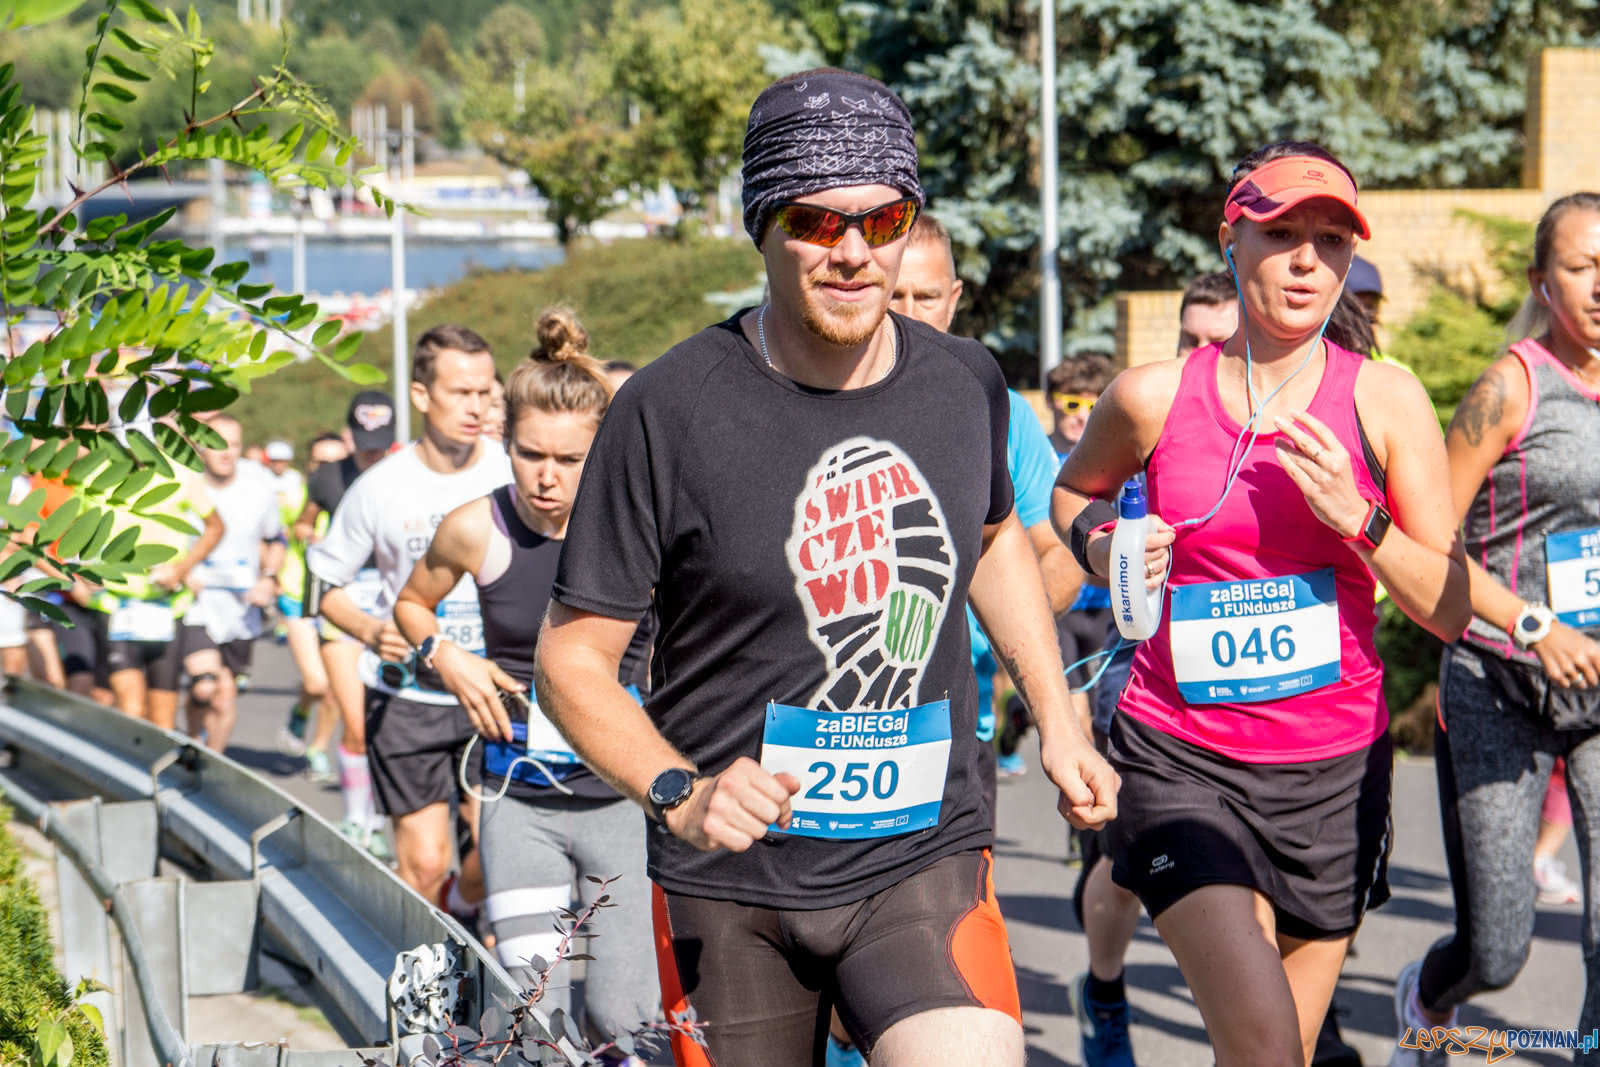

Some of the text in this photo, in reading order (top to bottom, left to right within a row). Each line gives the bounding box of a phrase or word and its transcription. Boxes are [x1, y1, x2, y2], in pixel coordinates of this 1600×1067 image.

[799, 509, 890, 572] CZE
[803, 559, 890, 617] WO
[1119, 553, 1132, 613] karrimor
[1210, 579, 1295, 603] zaBIEGaj
[885, 589, 941, 662] RUN
[1211, 599, 1296, 618] o FUNdusze
[1211, 624, 1297, 669] 046
[815, 712, 909, 733] zaBIEGaj
[815, 734, 908, 748] o FUNdusze
[804, 760, 900, 802] 250
